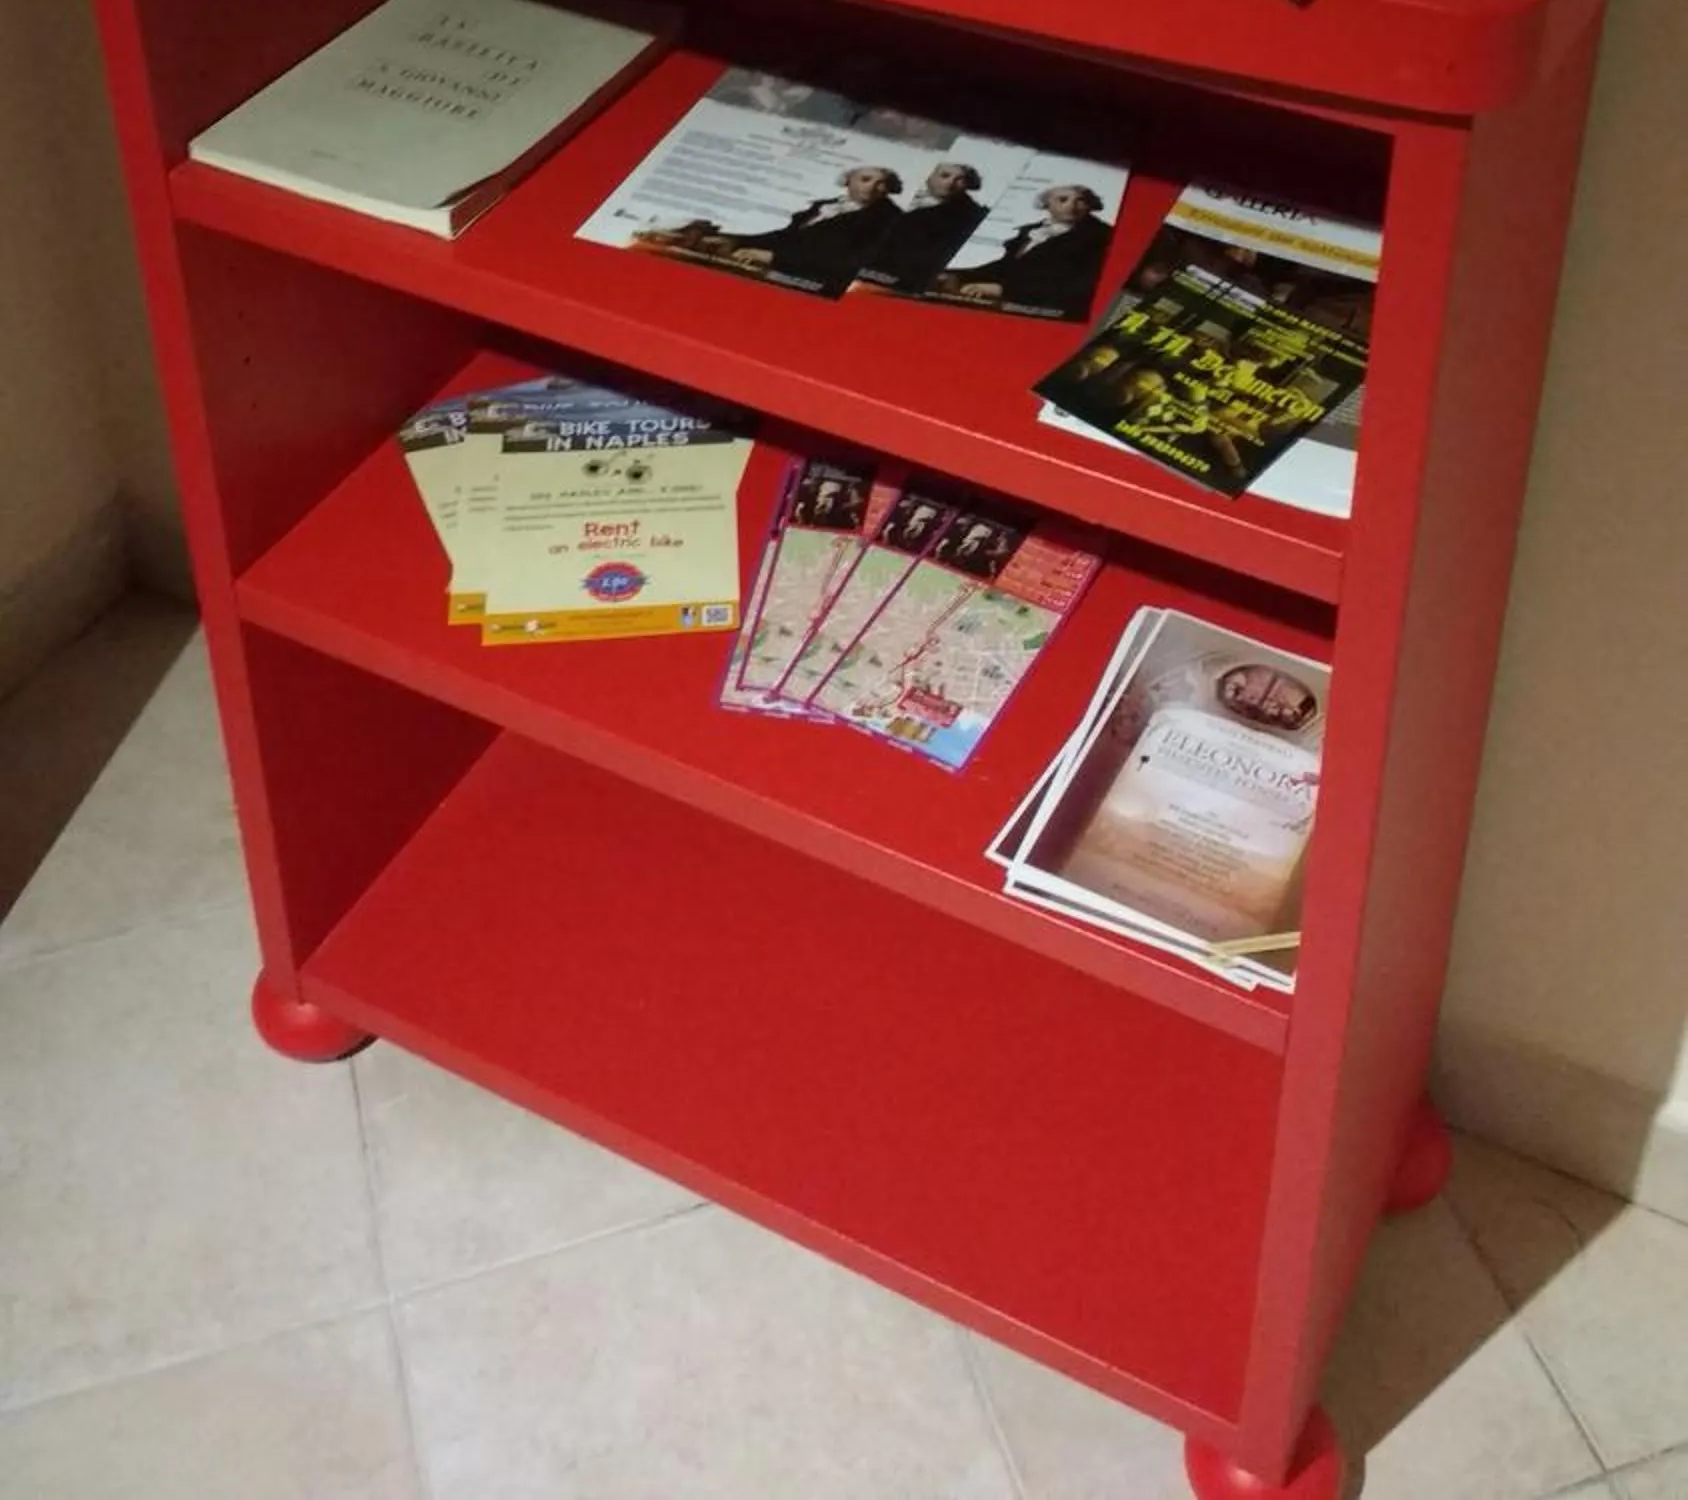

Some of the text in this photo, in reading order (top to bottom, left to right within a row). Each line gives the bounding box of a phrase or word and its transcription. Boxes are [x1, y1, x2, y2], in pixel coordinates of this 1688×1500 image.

[560, 419, 611, 437] BIKE
[547, 432, 689, 451] IN NAPLES
[583, 519, 641, 539] Rent
[576, 536, 642, 552] electric
[649, 535, 685, 550] bike
